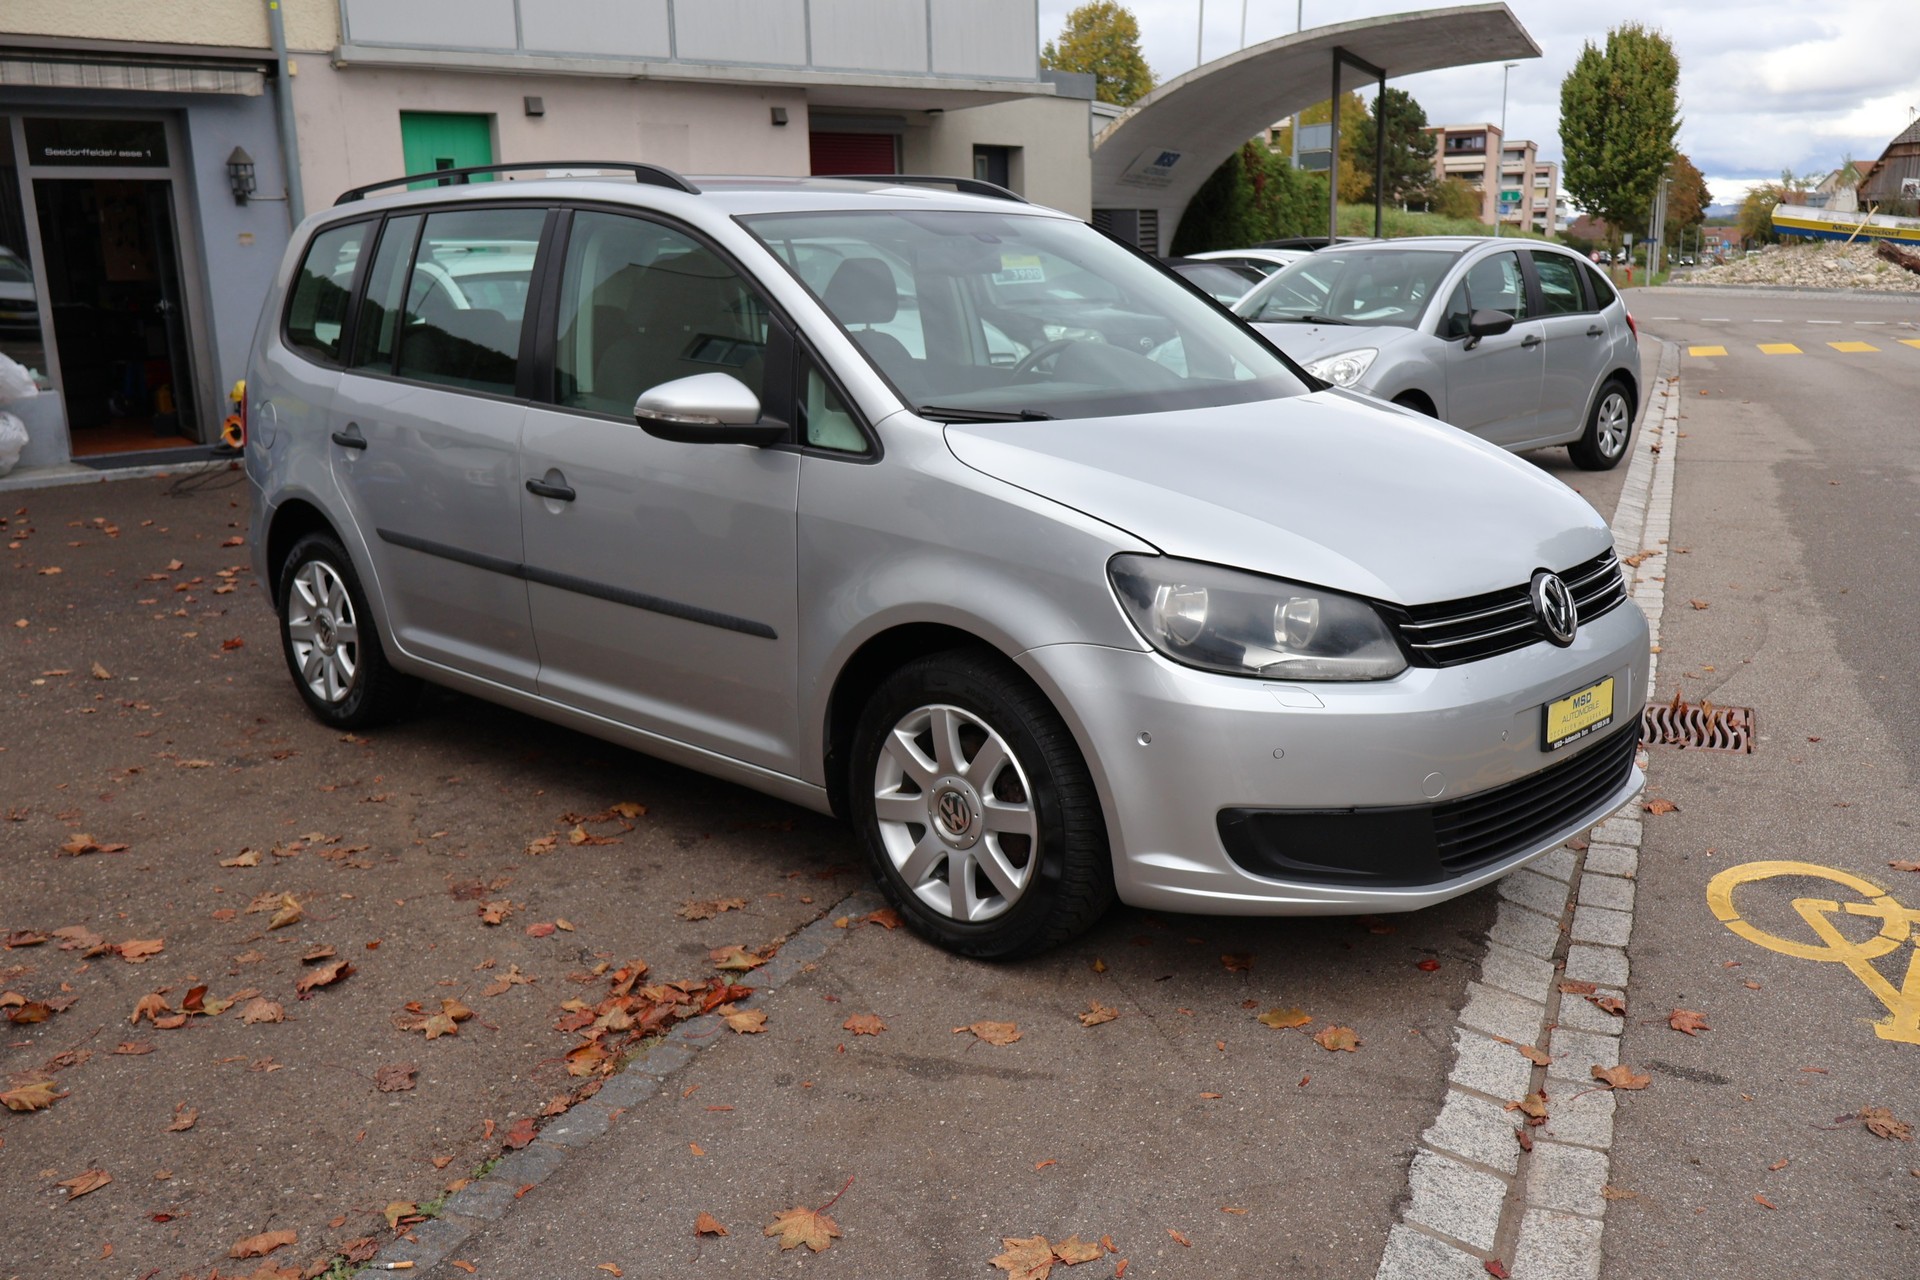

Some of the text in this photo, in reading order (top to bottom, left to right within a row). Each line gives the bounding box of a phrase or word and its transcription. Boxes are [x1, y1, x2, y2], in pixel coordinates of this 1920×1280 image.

[146, 149, 151, 157] 1
[1832, 223, 1900, 236] Mooseedorf
[1573, 692, 1592, 709] MSD
[1562, 700, 1600, 723] AUTOMOBILE
